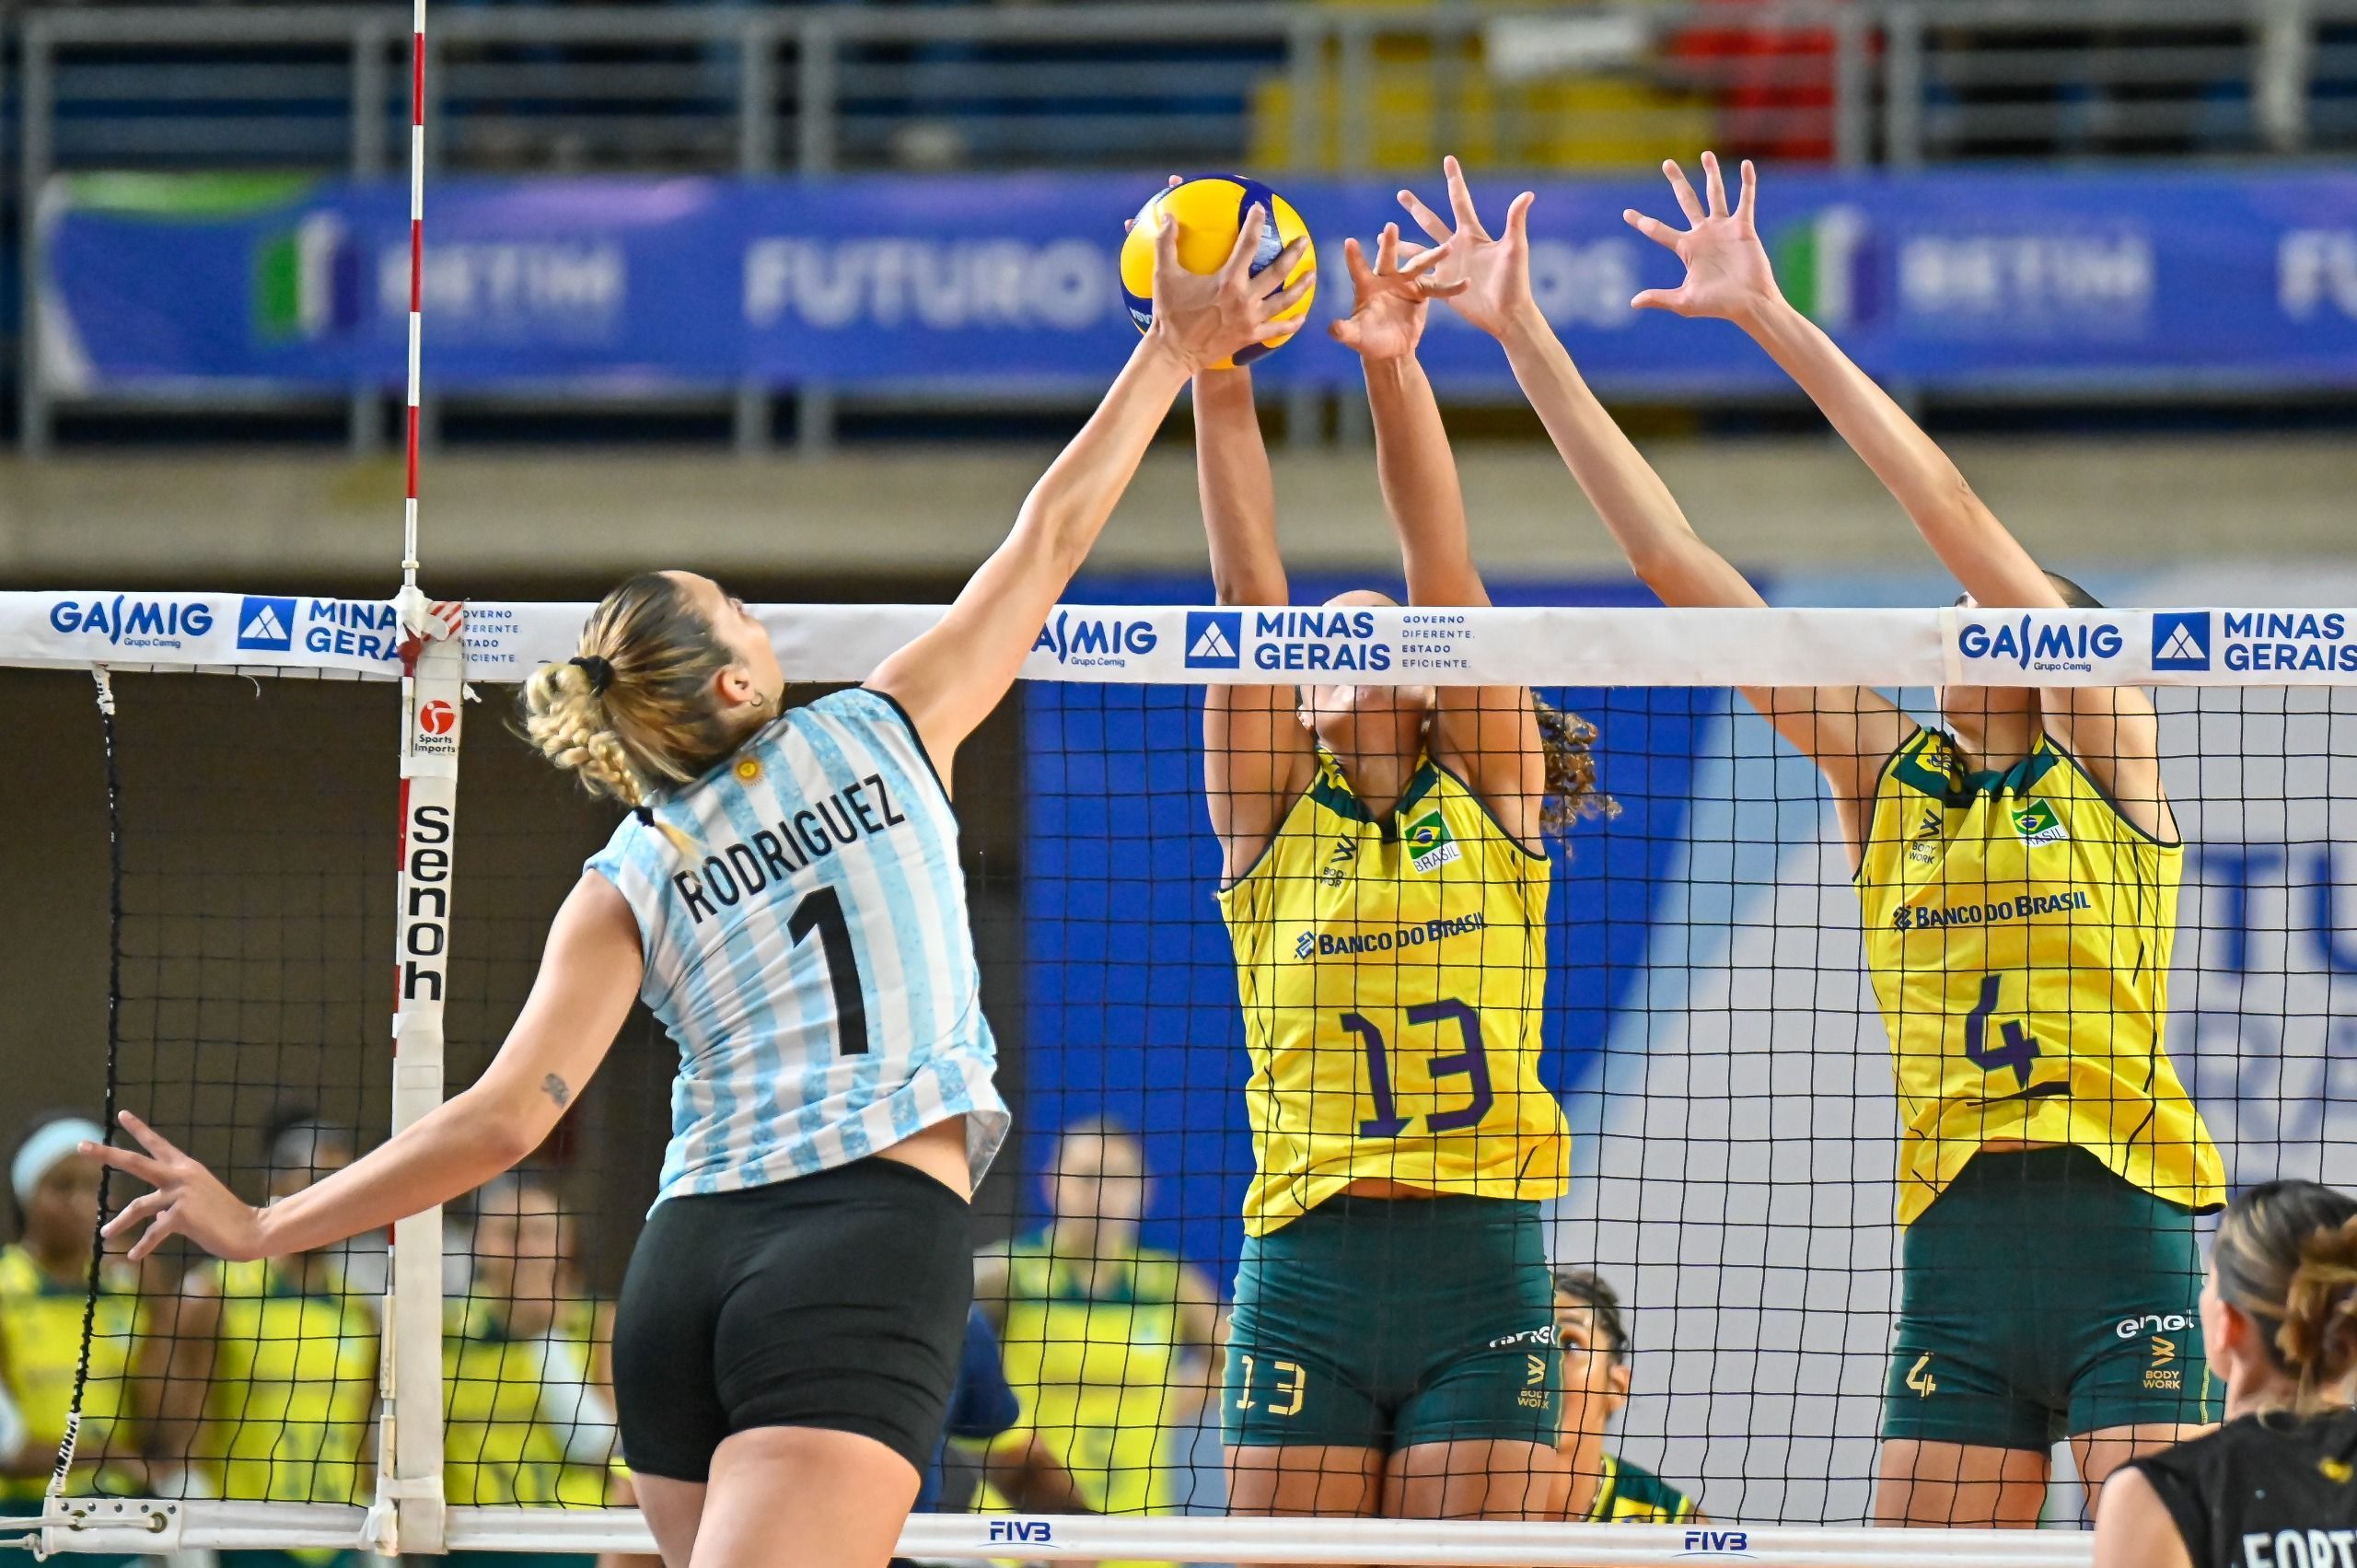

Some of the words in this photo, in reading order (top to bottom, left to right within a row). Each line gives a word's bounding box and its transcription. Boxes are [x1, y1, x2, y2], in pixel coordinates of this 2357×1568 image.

[743, 237, 1109, 329] FUTURO
[50, 594, 214, 645] GASMIG
[308, 599, 397, 631] MINA
[1255, 611, 1375, 639] MINAS
[1402, 615, 1465, 624] GOVERNO
[2223, 611, 2345, 640] MINAS
[1030, 610, 1157, 665] ASMIG
[1401, 630, 1475, 639] DIFERENTE.
[1958, 613, 2123, 670] GASMIG
[1071, 656, 1096, 667] Grupo
[1254, 643, 1391, 671] GERAIS
[1401, 645, 1451, 654] ESTADO
[1401, 659, 1471, 668] EFICIENTE.
[2223, 643, 2357, 672] GERAIS
[2033, 662, 2061, 672] Grupo
[2062, 662, 2092, 672] Cemig
[413, 743, 456, 754] Imports
[419, 734, 452, 744] Sports
[673, 773, 906, 923] RODRIGUEZ
[404, 806, 449, 1001] Senoh
[1915, 906, 1982, 928] BANCO
[1983, 901, 2014, 922] DO
[2014, 890, 2092, 917] BRASIL
[1318, 932, 1393, 955] BANCO
[1395, 926, 1424, 947] DO
[1427, 912, 1488, 942] BRASIL
[786, 886, 869, 1056] 1
[1965, 974, 2041, 1089] 4
[1340, 997, 1494, 1139] 13
[2117, 1308, 2195, 1339] enel
[1236, 1354, 1306, 1416] 13
[1905, 1352, 1936, 1398] 4
[2142, 1379, 2181, 1389] WORK
[2145, 1370, 2180, 1379] BODY
[990, 1521, 1051, 1542] FIVB
[1684, 1530, 1747, 1551] FIVB
